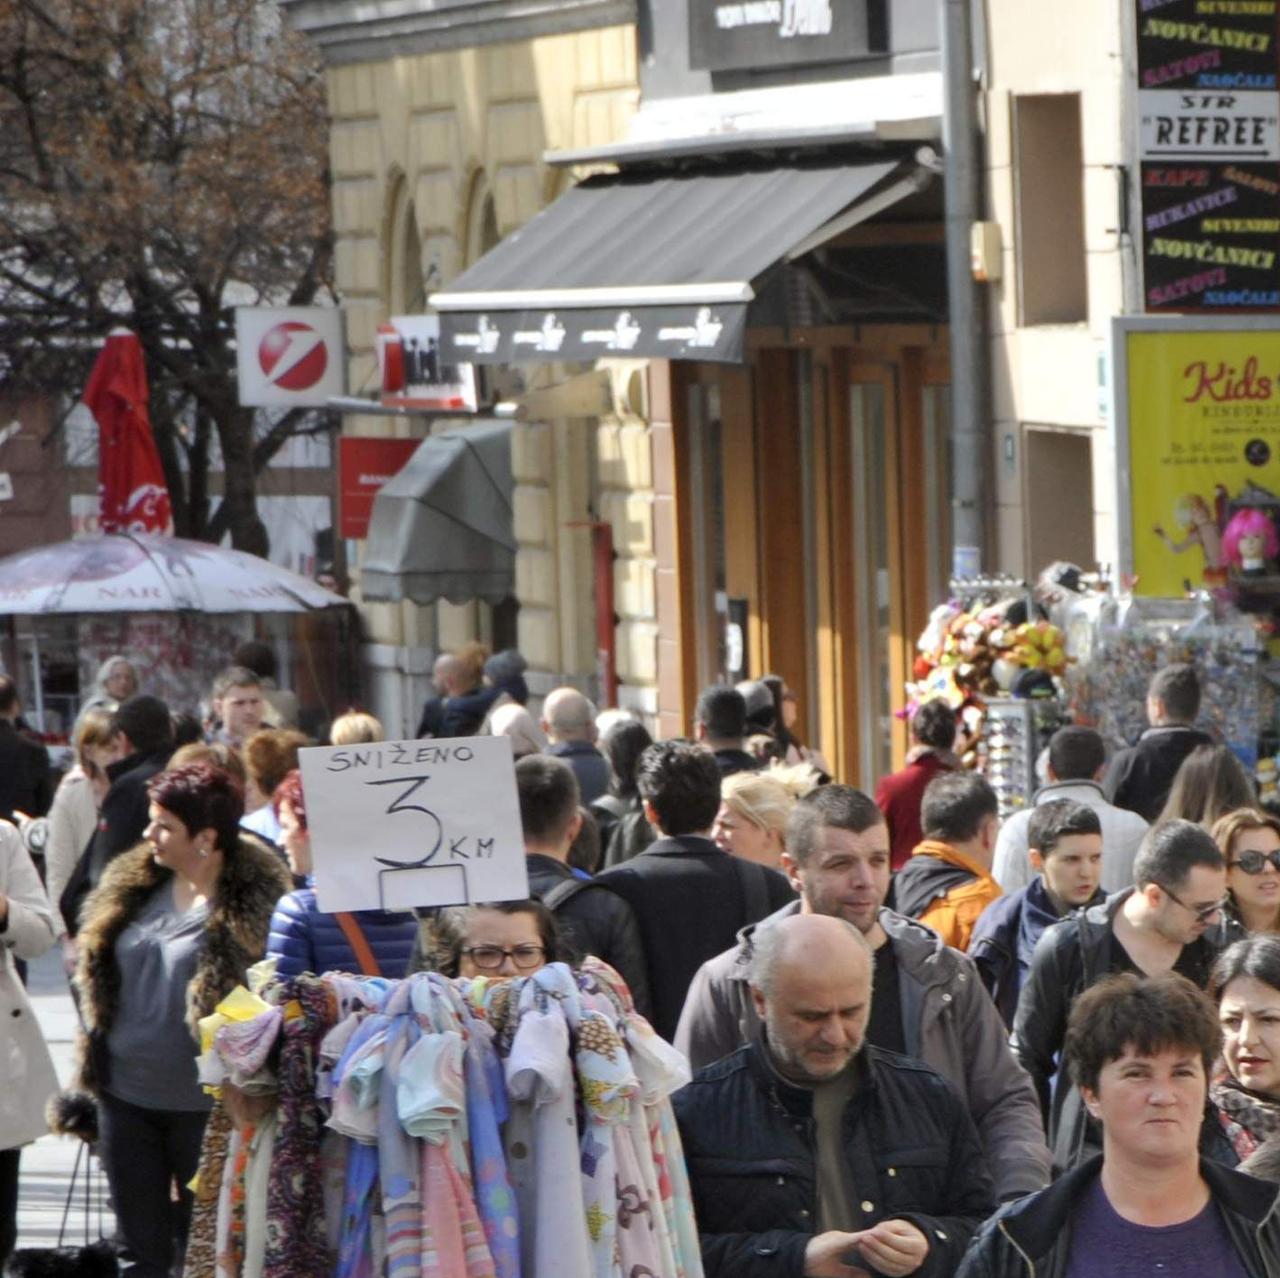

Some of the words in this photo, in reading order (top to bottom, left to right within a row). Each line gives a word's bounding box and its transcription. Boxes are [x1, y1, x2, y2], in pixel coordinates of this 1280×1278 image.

[1143, 18, 1271, 53] NOVČANICI
[1181, 95, 1237, 109] STR
[1149, 237, 1276, 270] NOVČANICI
[1183, 355, 1273, 404] Kids
[326, 744, 475, 772] SNIŽENO
[364, 775, 444, 870] 3
[449, 835, 495, 860] KM
